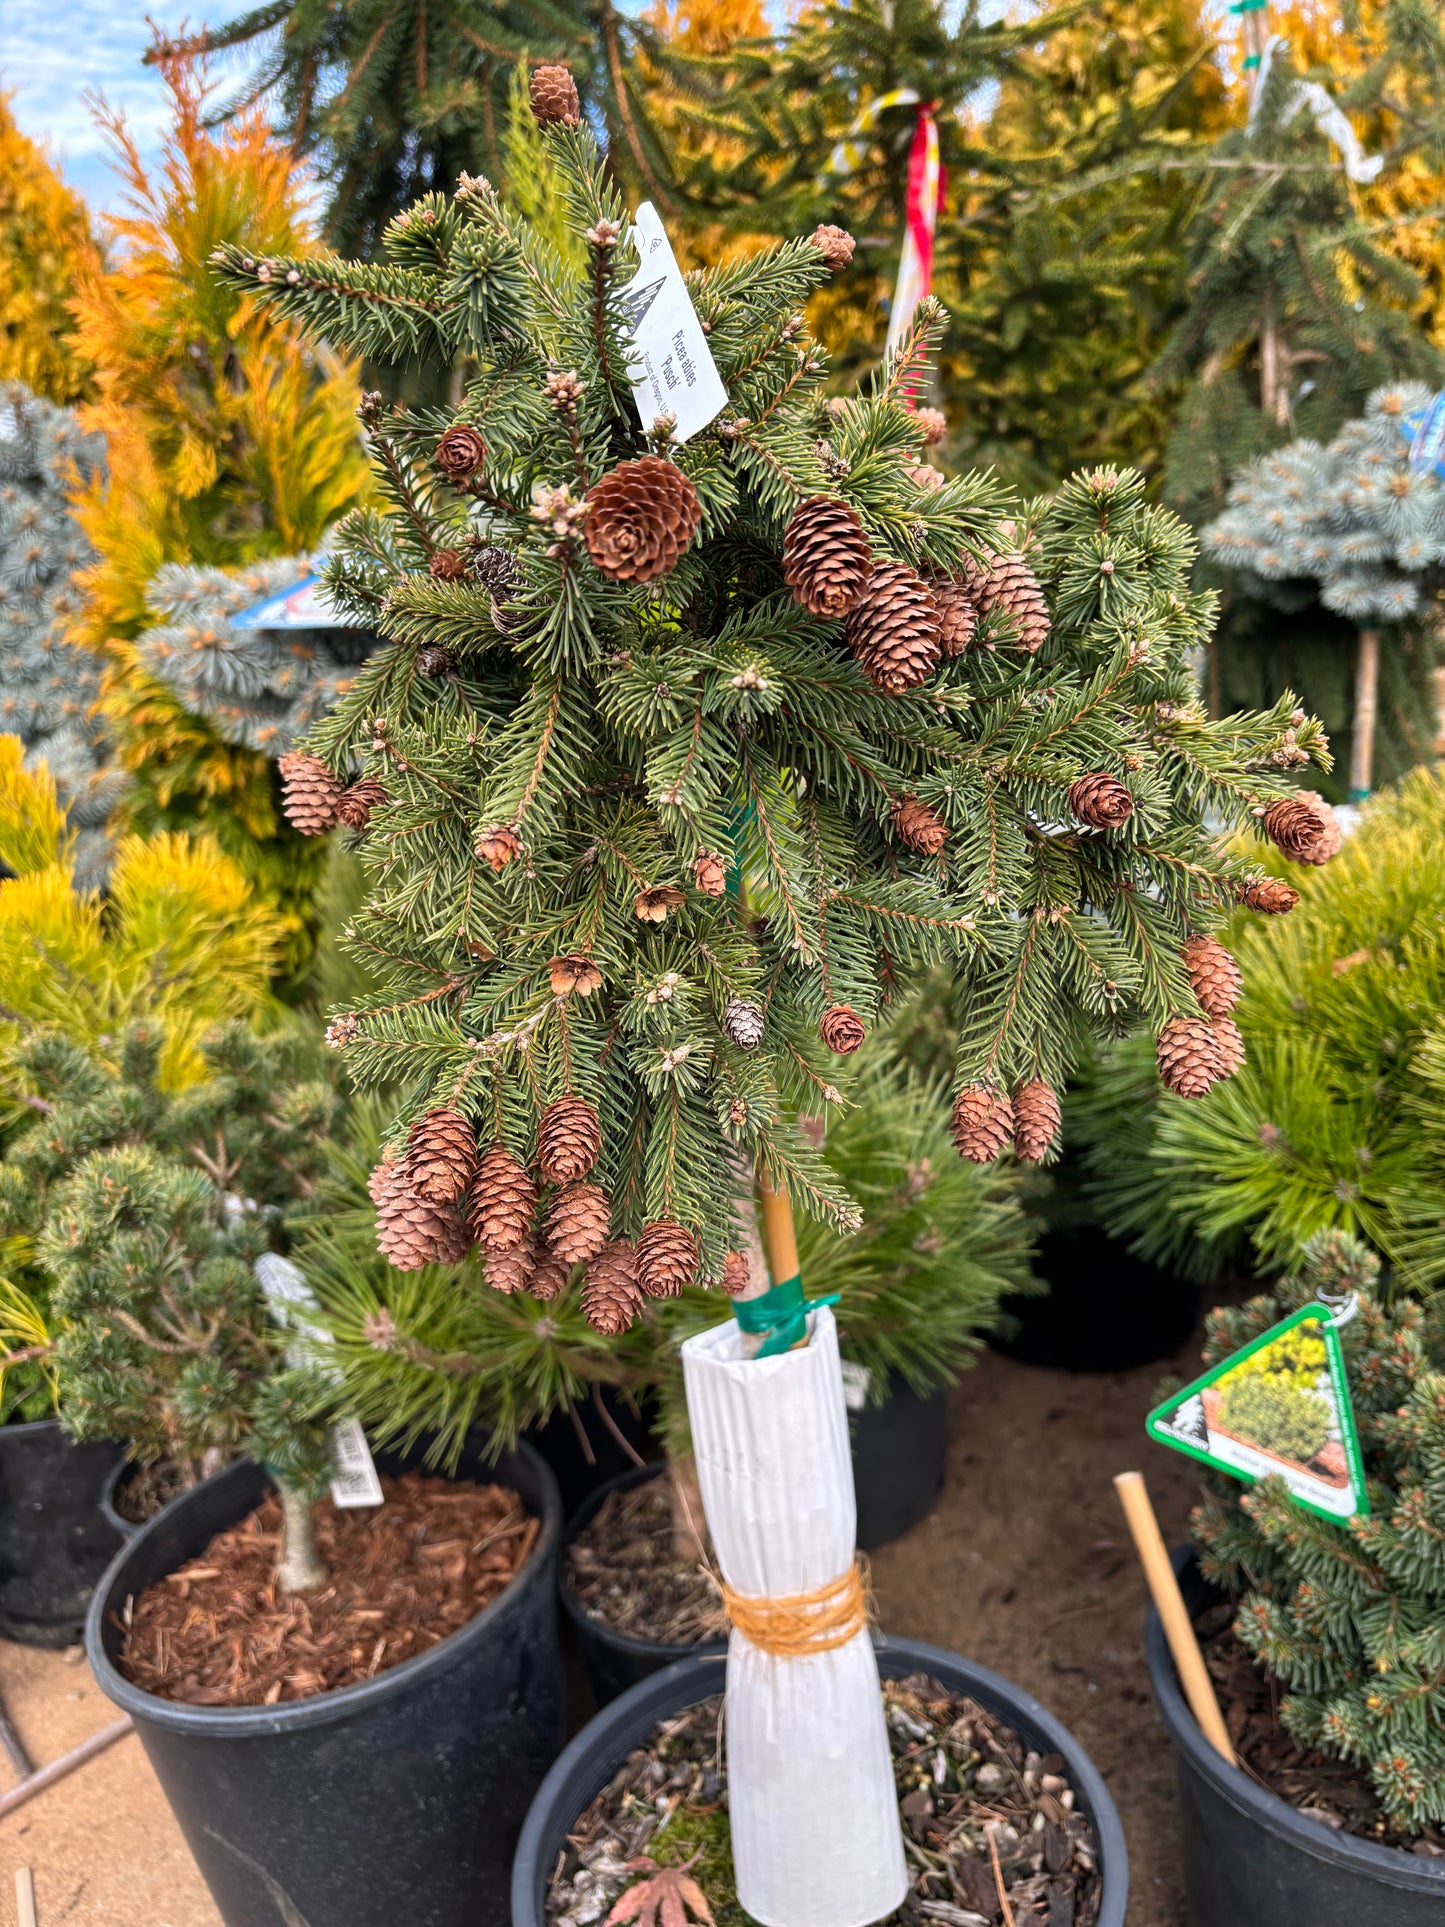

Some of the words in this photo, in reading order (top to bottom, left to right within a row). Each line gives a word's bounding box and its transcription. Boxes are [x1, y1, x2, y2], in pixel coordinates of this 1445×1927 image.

[661, 353, 681, 391] 'Pusch'
[672, 329, 687, 361] Picea
[681, 359, 697, 387] abies
